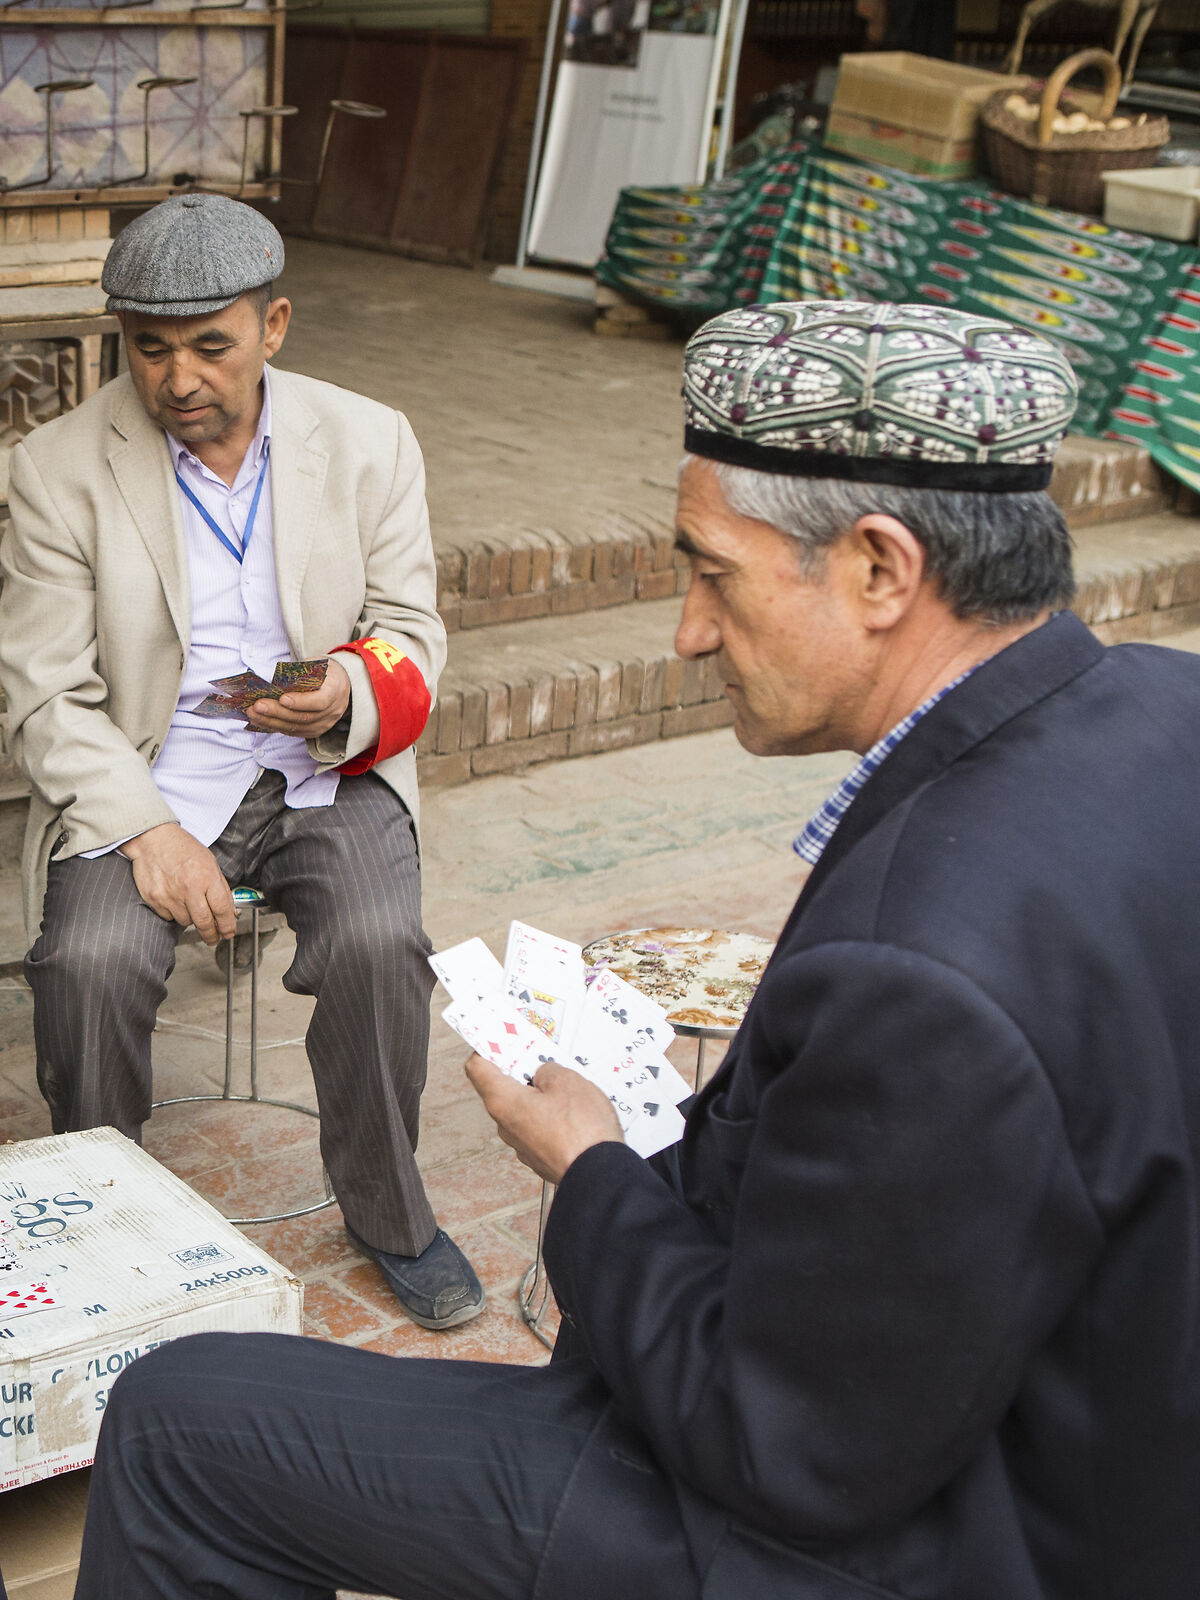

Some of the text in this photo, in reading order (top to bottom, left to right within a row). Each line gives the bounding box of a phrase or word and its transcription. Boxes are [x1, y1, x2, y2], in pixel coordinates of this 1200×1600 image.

[632, 1037, 646, 1048] 2
[620, 1057, 635, 1069] 3
[634, 1073, 648, 1085] 3
[179, 1264, 269, 1292] 24x500g
[52, 1457, 96, 1475] ROTHERS
